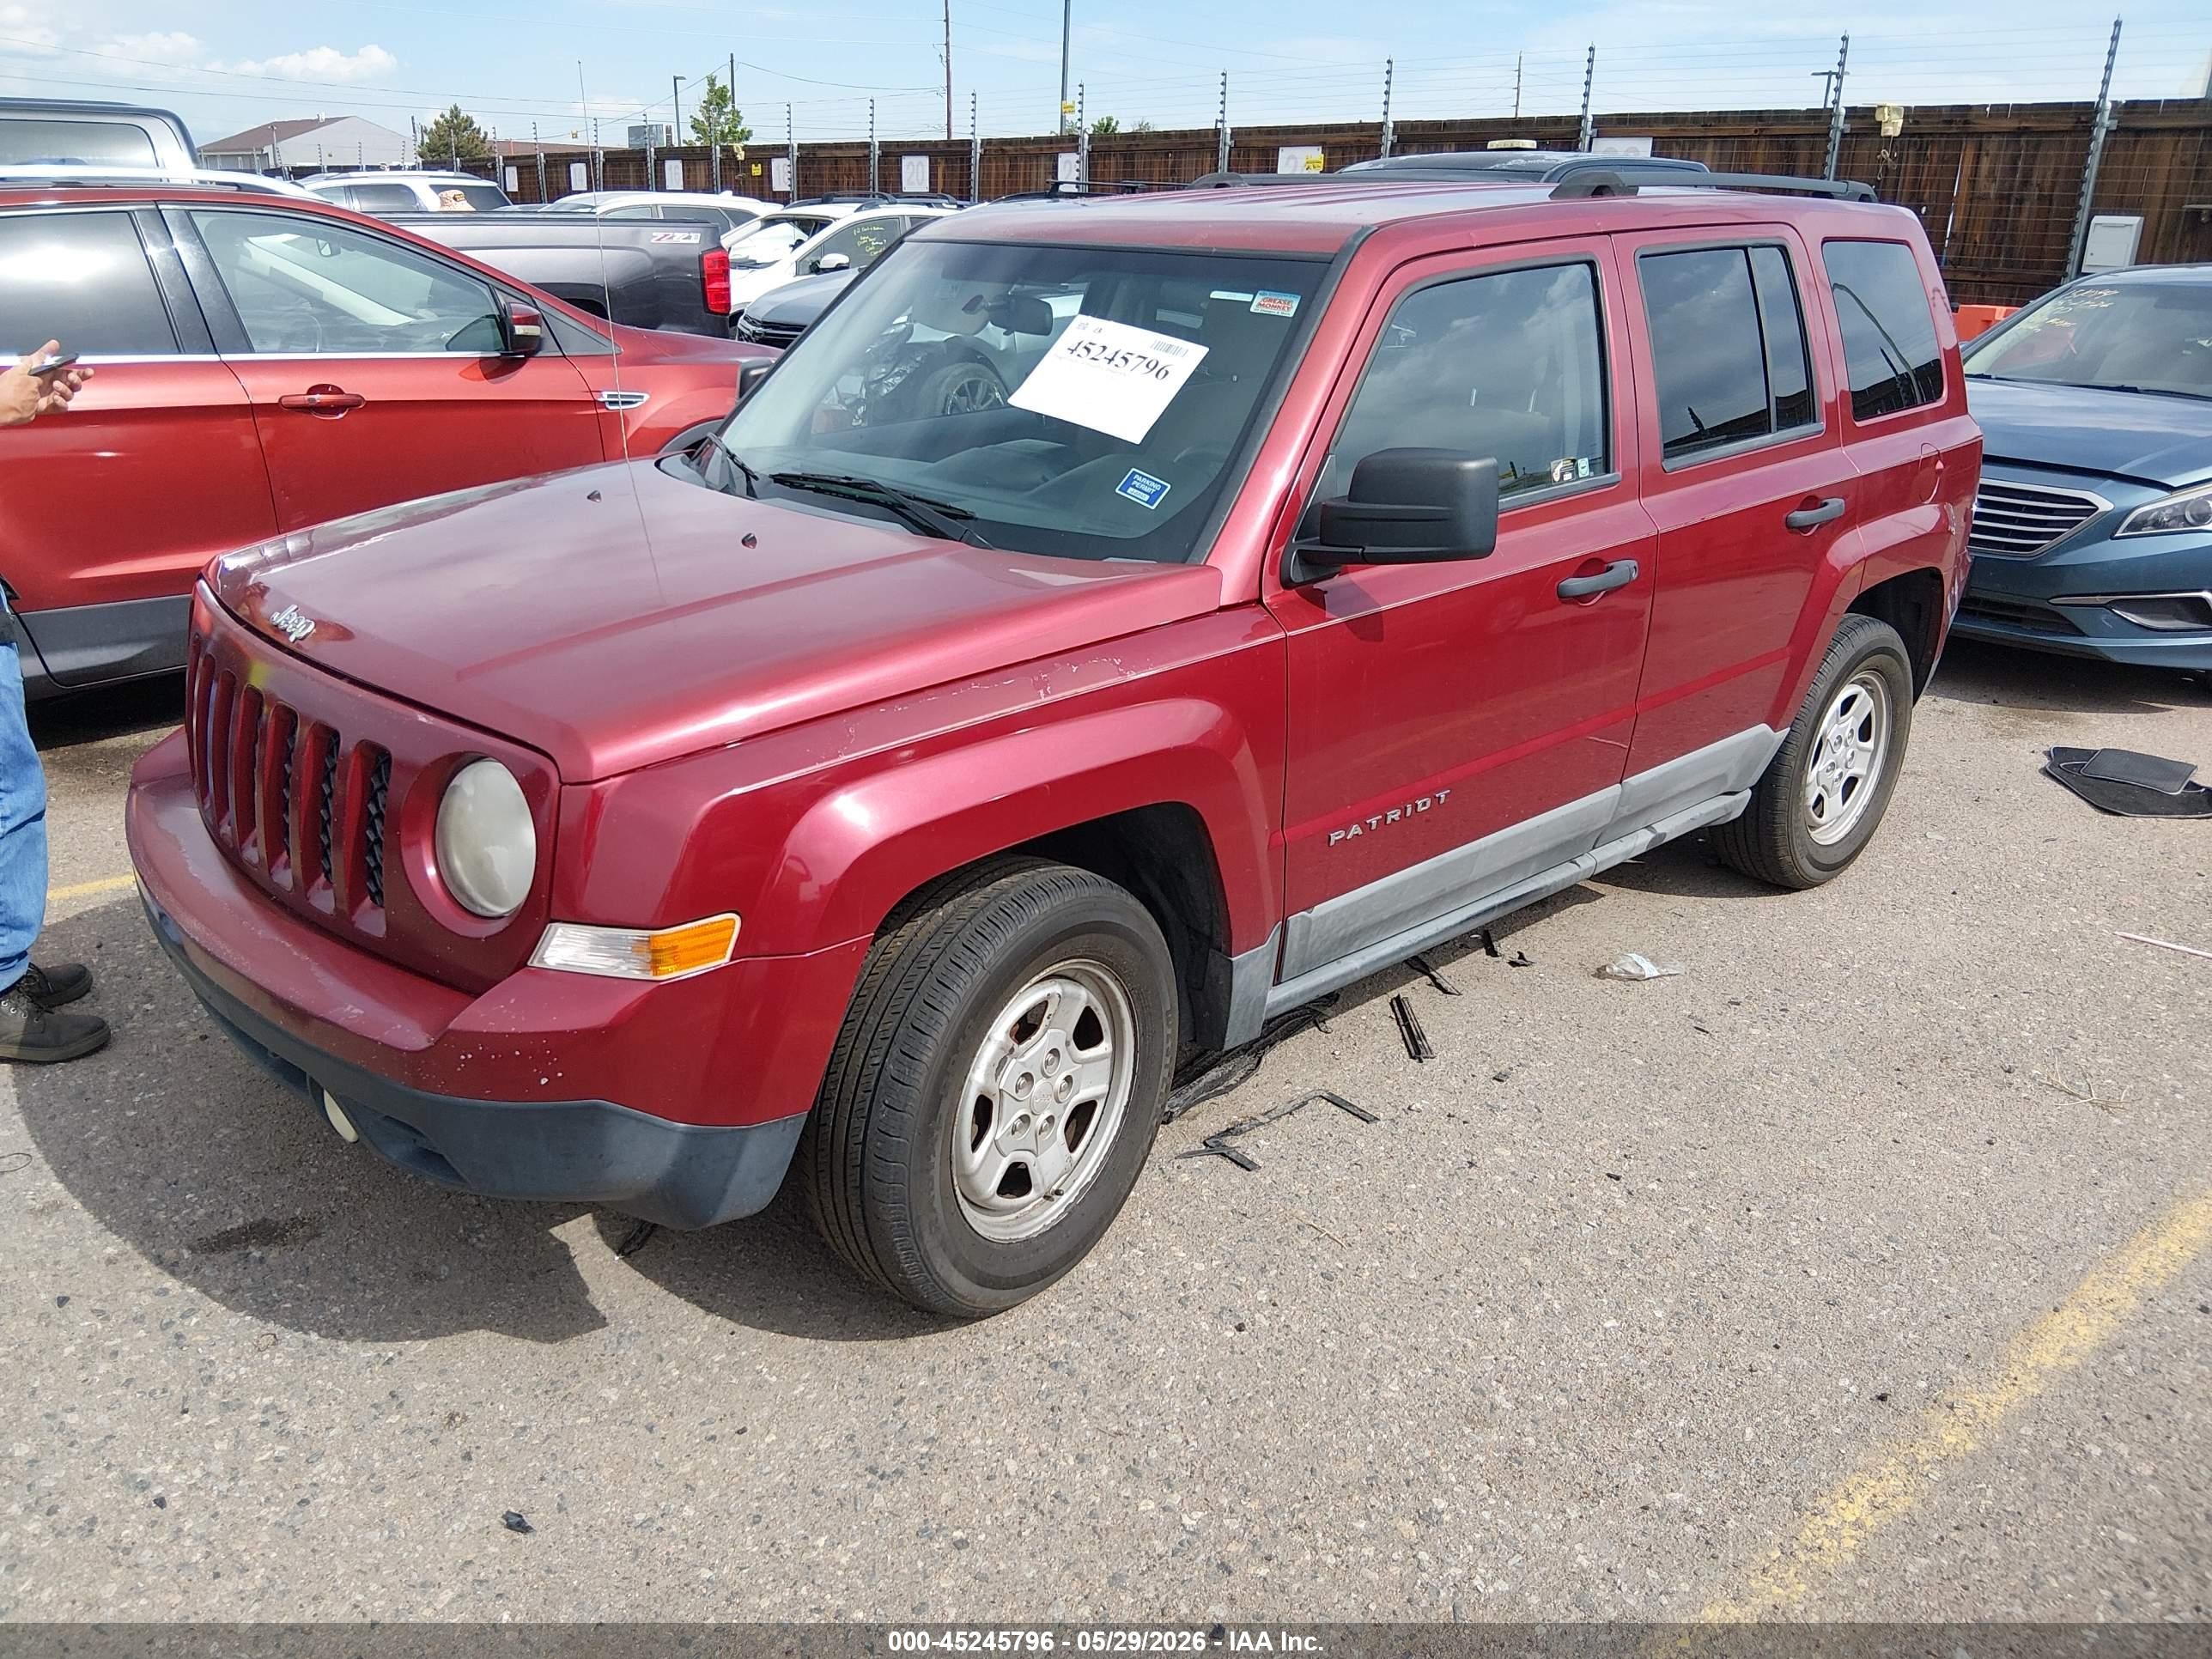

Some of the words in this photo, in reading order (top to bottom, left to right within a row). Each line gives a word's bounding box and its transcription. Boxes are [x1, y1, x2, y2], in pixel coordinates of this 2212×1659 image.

[906, 160, 925, 186] 20
[1256, 302, 1292, 312] MONKEY
[1261, 297, 1293, 306] GREASE
[1066, 340, 1176, 380] 45245796
[1131, 480, 1157, 495] PERMIT
[1133, 474, 1162, 491] PARKING
[270, 605, 315, 642] Jeep
[1328, 789, 1451, 847] PATRIOT
